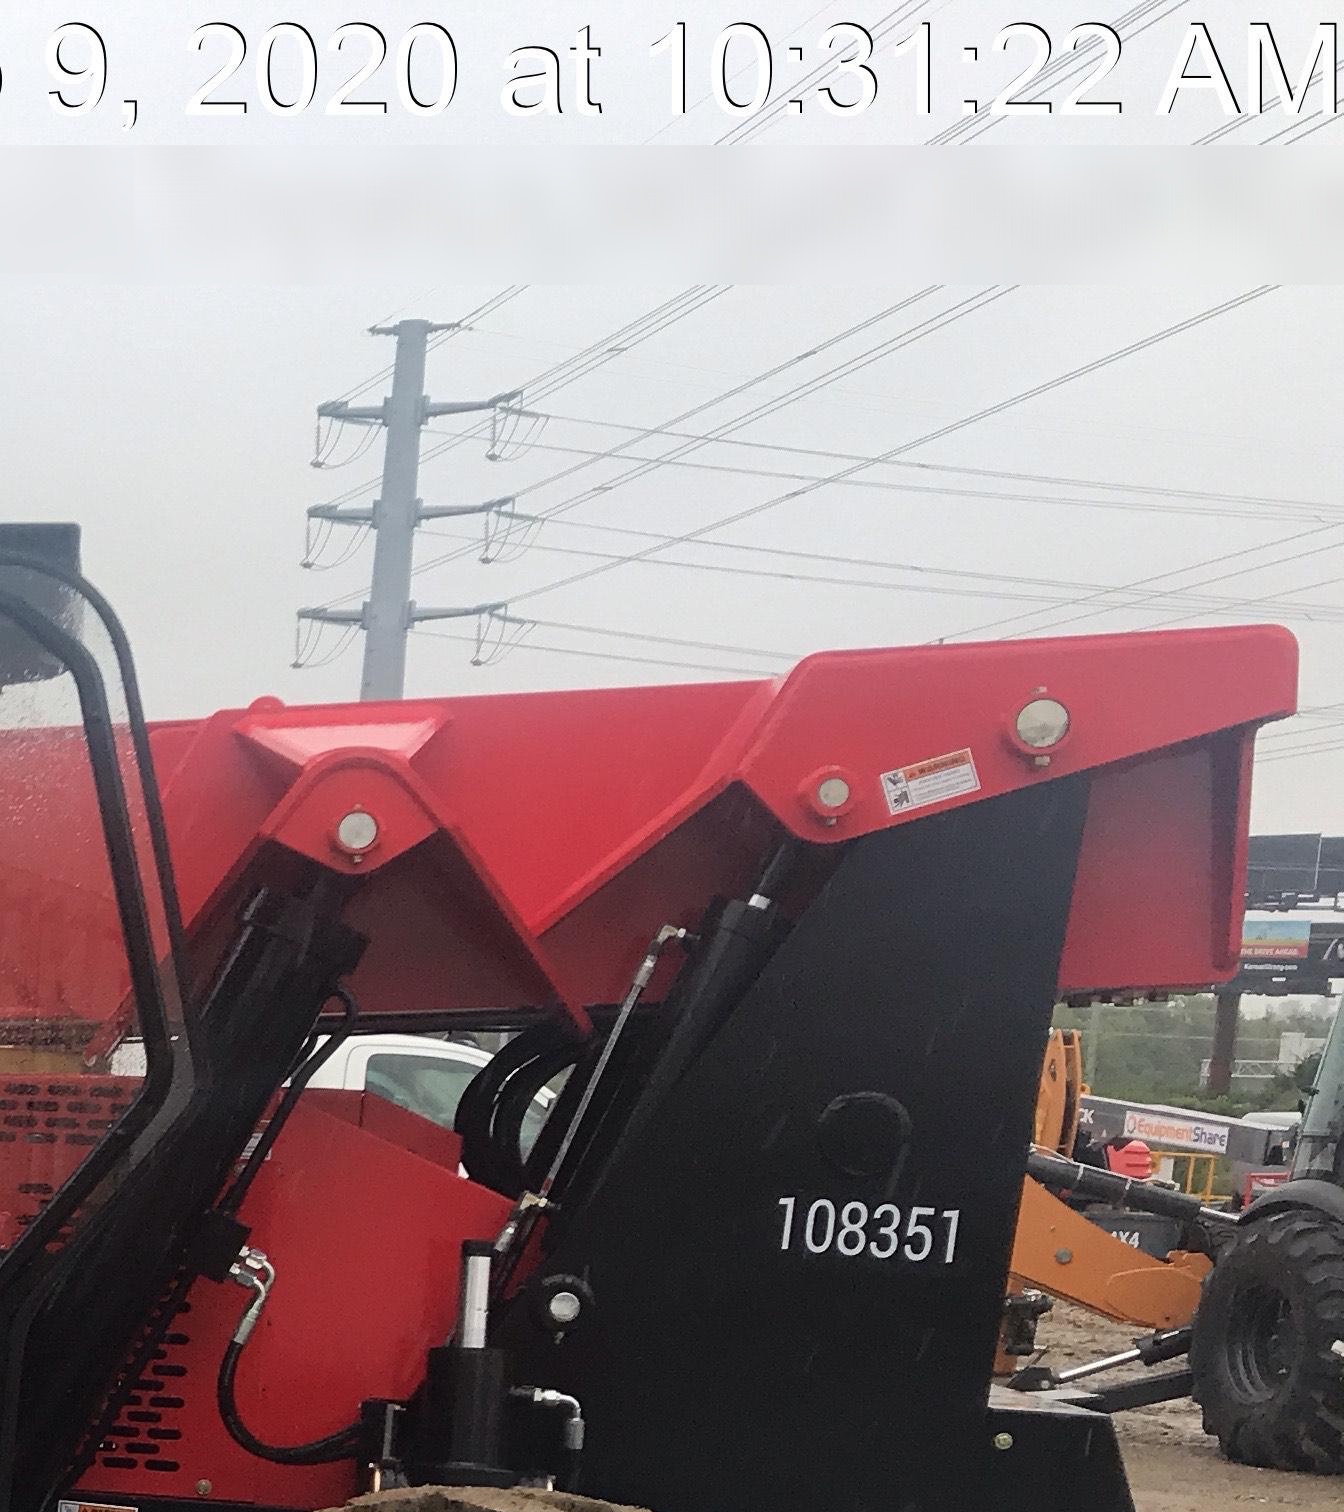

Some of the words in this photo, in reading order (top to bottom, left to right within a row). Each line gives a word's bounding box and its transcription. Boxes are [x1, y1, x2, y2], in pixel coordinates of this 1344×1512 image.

[1136, 1117, 1226, 1148] EquipmentShare
[778, 1196, 960, 1263] 108351
[1111, 1231, 1140, 1249] X4
